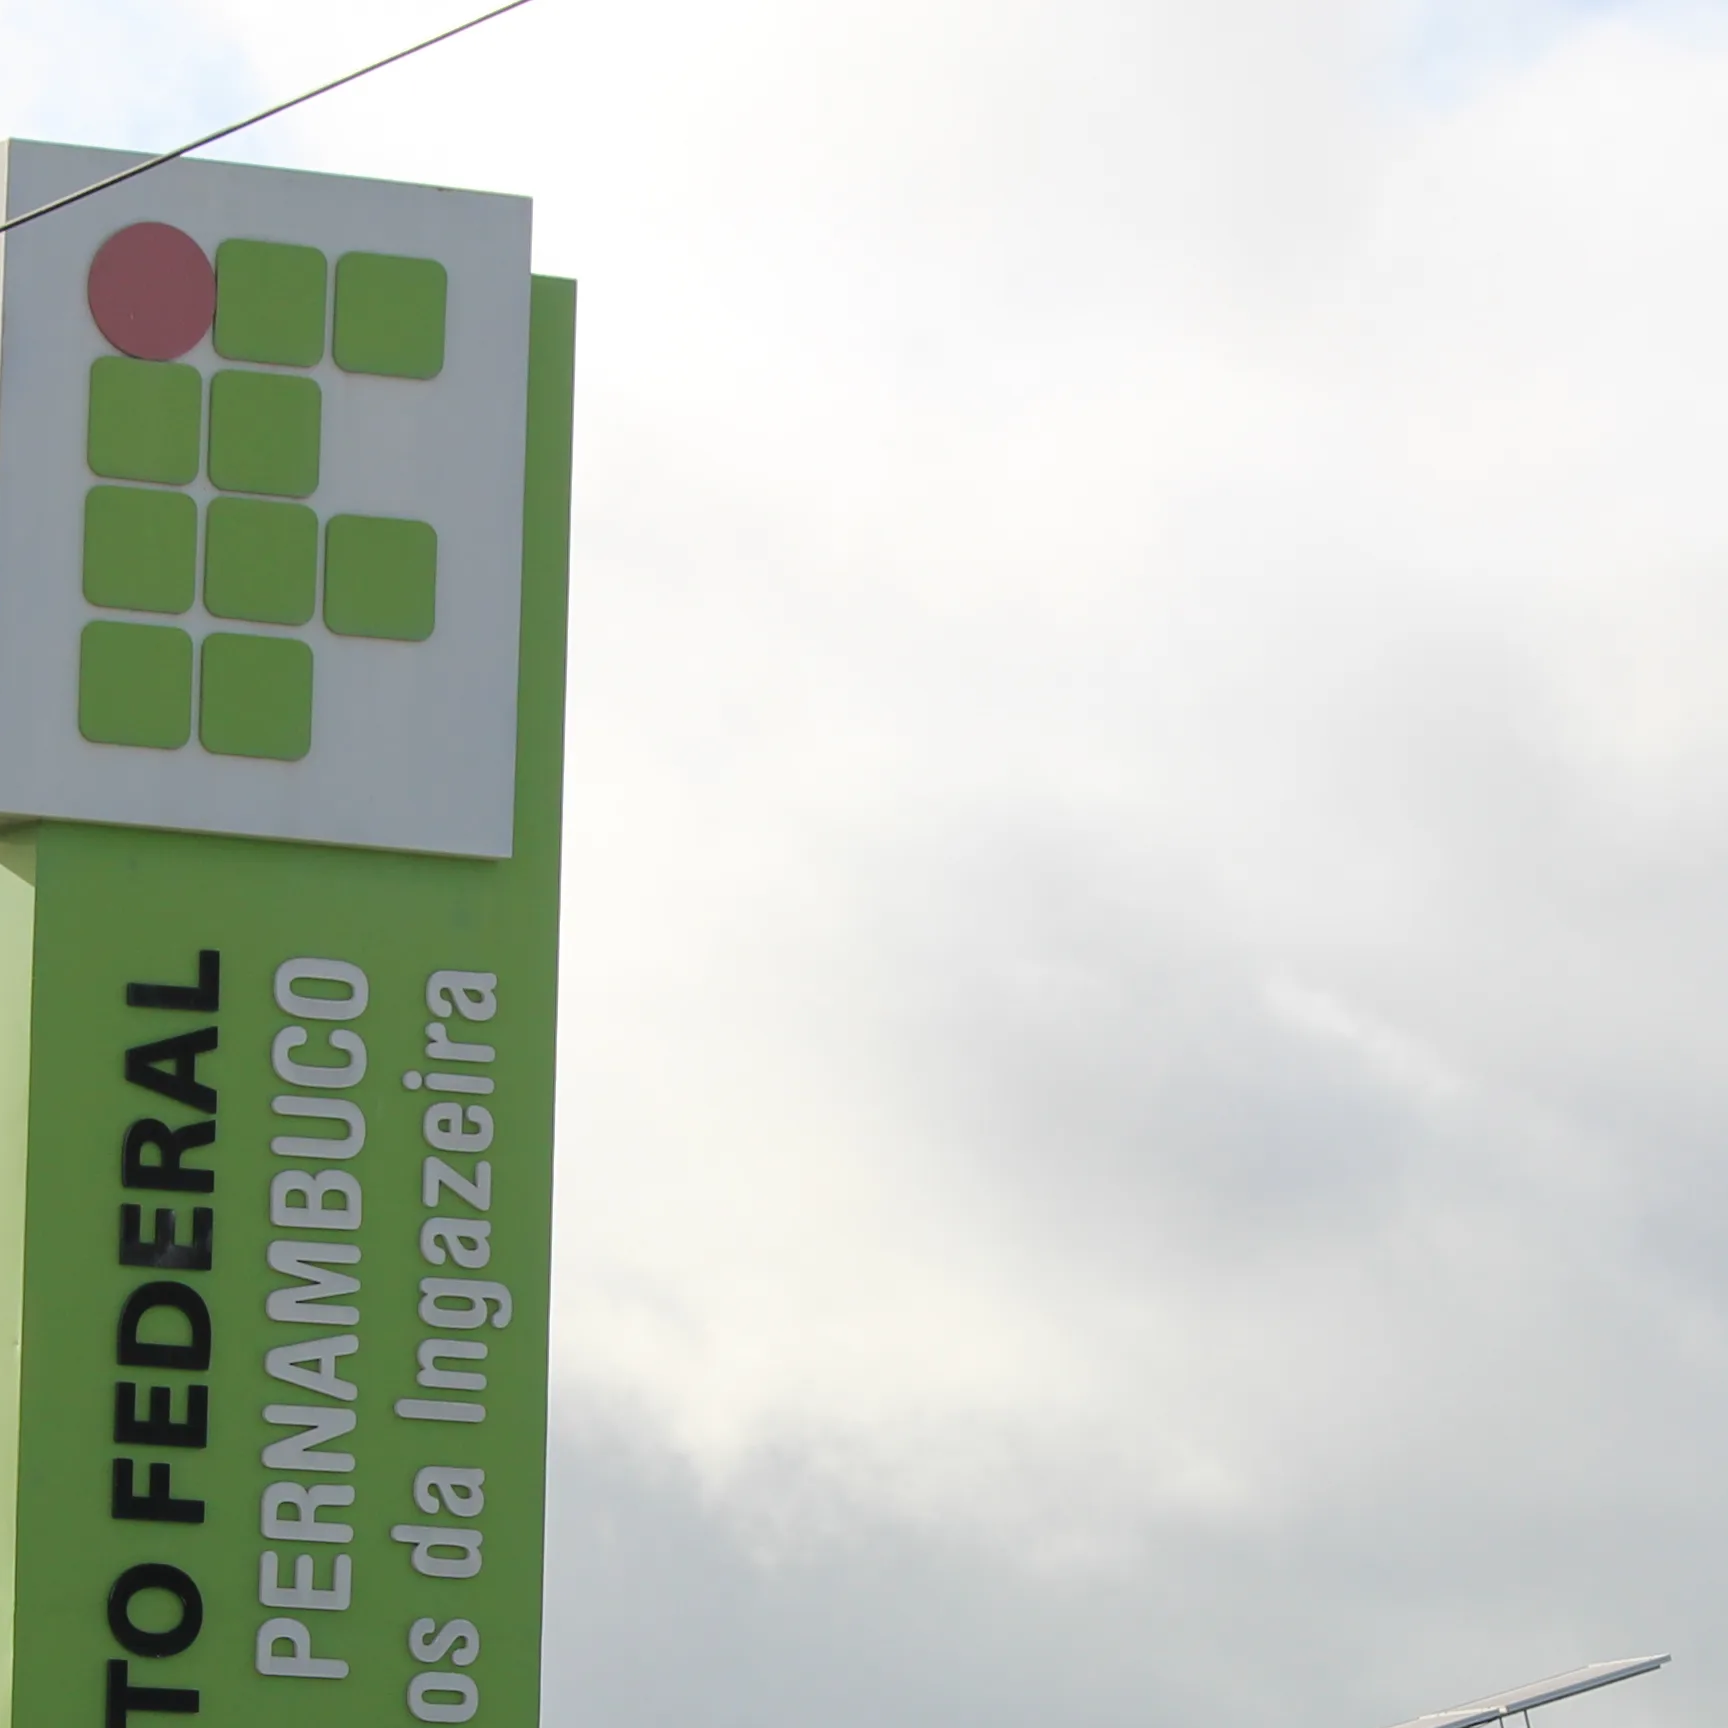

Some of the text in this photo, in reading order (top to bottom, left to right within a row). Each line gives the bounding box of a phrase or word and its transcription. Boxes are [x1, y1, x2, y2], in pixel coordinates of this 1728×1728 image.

[110, 949, 221, 1524] FEDERAL
[254, 957, 370, 1681] PERNAMBUCO
[394, 969, 513, 1423] Ingazeira
[390, 1466, 485, 1579] da
